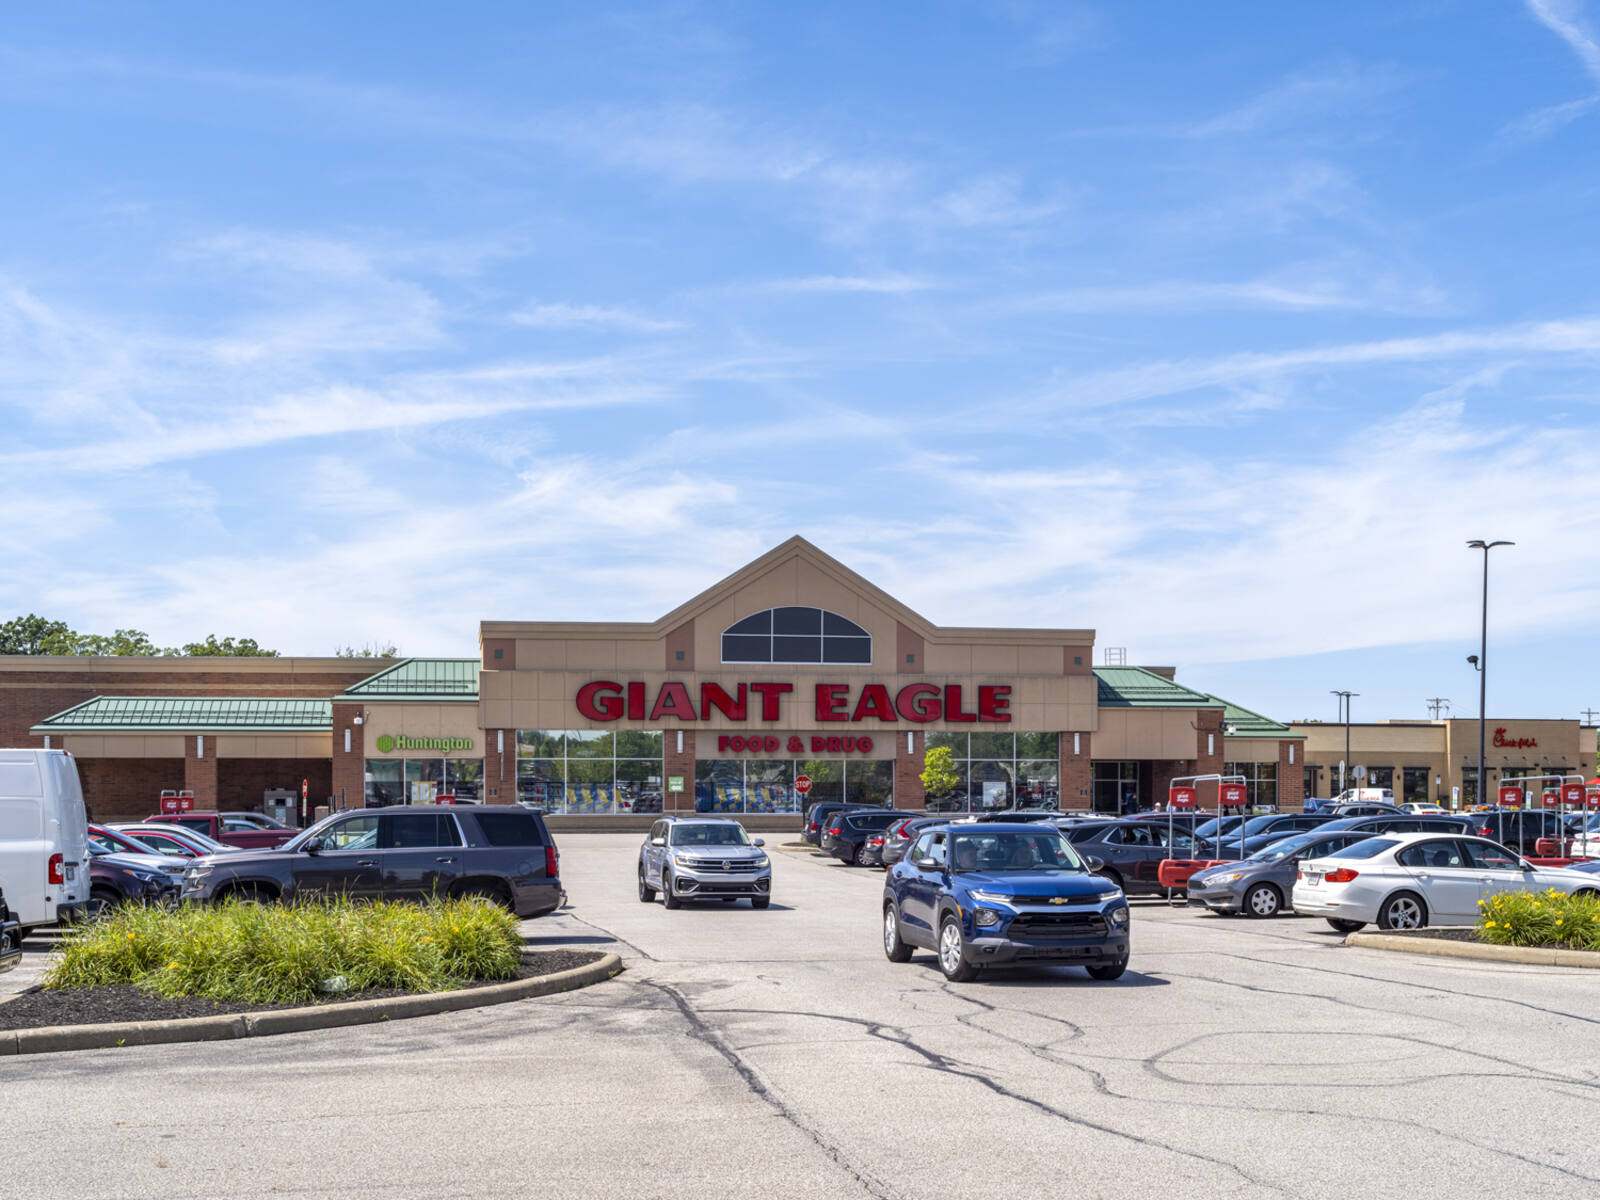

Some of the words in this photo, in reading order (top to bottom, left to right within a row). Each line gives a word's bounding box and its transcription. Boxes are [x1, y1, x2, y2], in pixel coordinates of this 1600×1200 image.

[576, 680, 793, 721] GIANT
[815, 683, 1012, 722] EAGLE
[396, 735, 472, 753] Huntington
[718, 735, 780, 753] FOOD
[787, 735, 804, 753] &
[811, 736, 874, 753] DRUG
[795, 780, 811, 788] STOP
